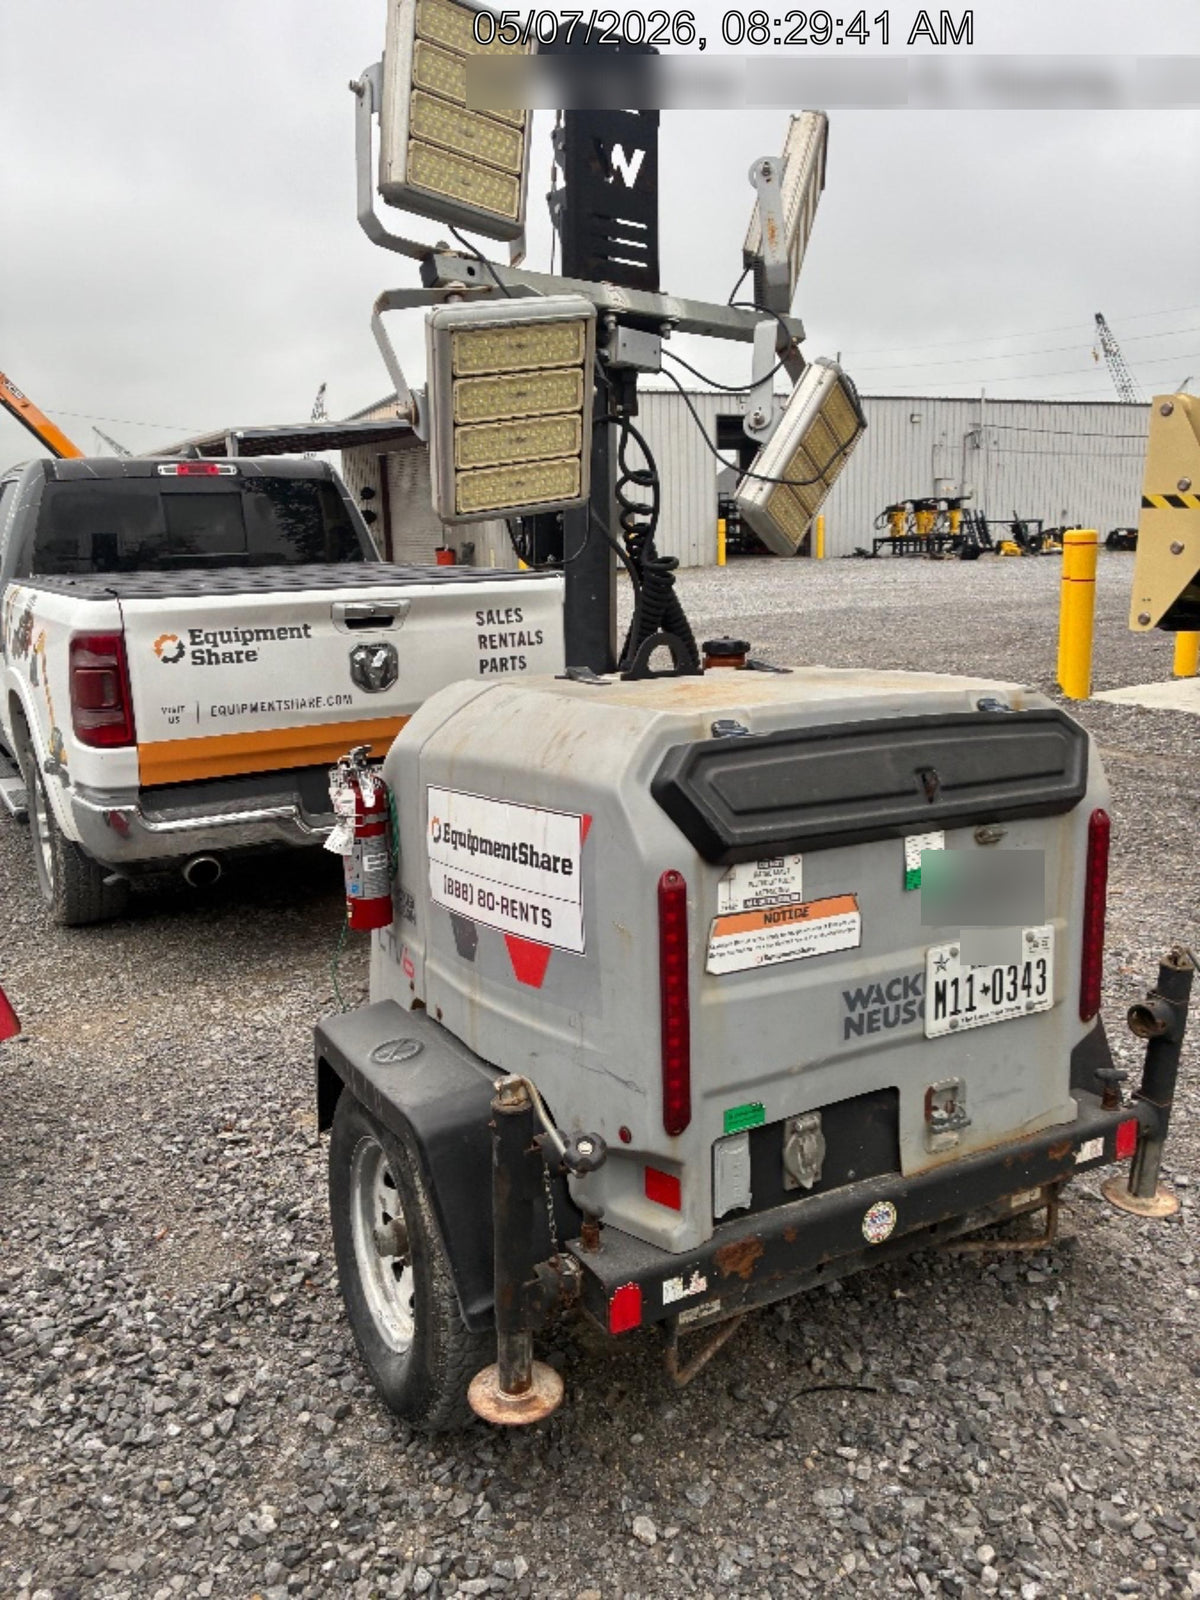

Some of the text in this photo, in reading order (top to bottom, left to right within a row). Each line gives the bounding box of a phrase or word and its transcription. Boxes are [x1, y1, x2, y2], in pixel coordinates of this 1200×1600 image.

[475, 607, 524, 626] SALES
[188, 623, 312, 648] Equipment
[478, 629, 543, 649] RENTALS
[191, 649, 258, 666] Share
[479, 655, 527, 674] PARTS
[210, 694, 353, 717] EQUIPMENTSHARE.COM
[168, 716, 180, 725] US
[442, 822, 574, 876] EquipmentShare
[443, 874, 552, 929] (888) 80-RENTS
[763, 906, 810, 925] NOTICE
[991, 957, 1047, 1005] 0343
[842, 971, 926, 1013] WACK
